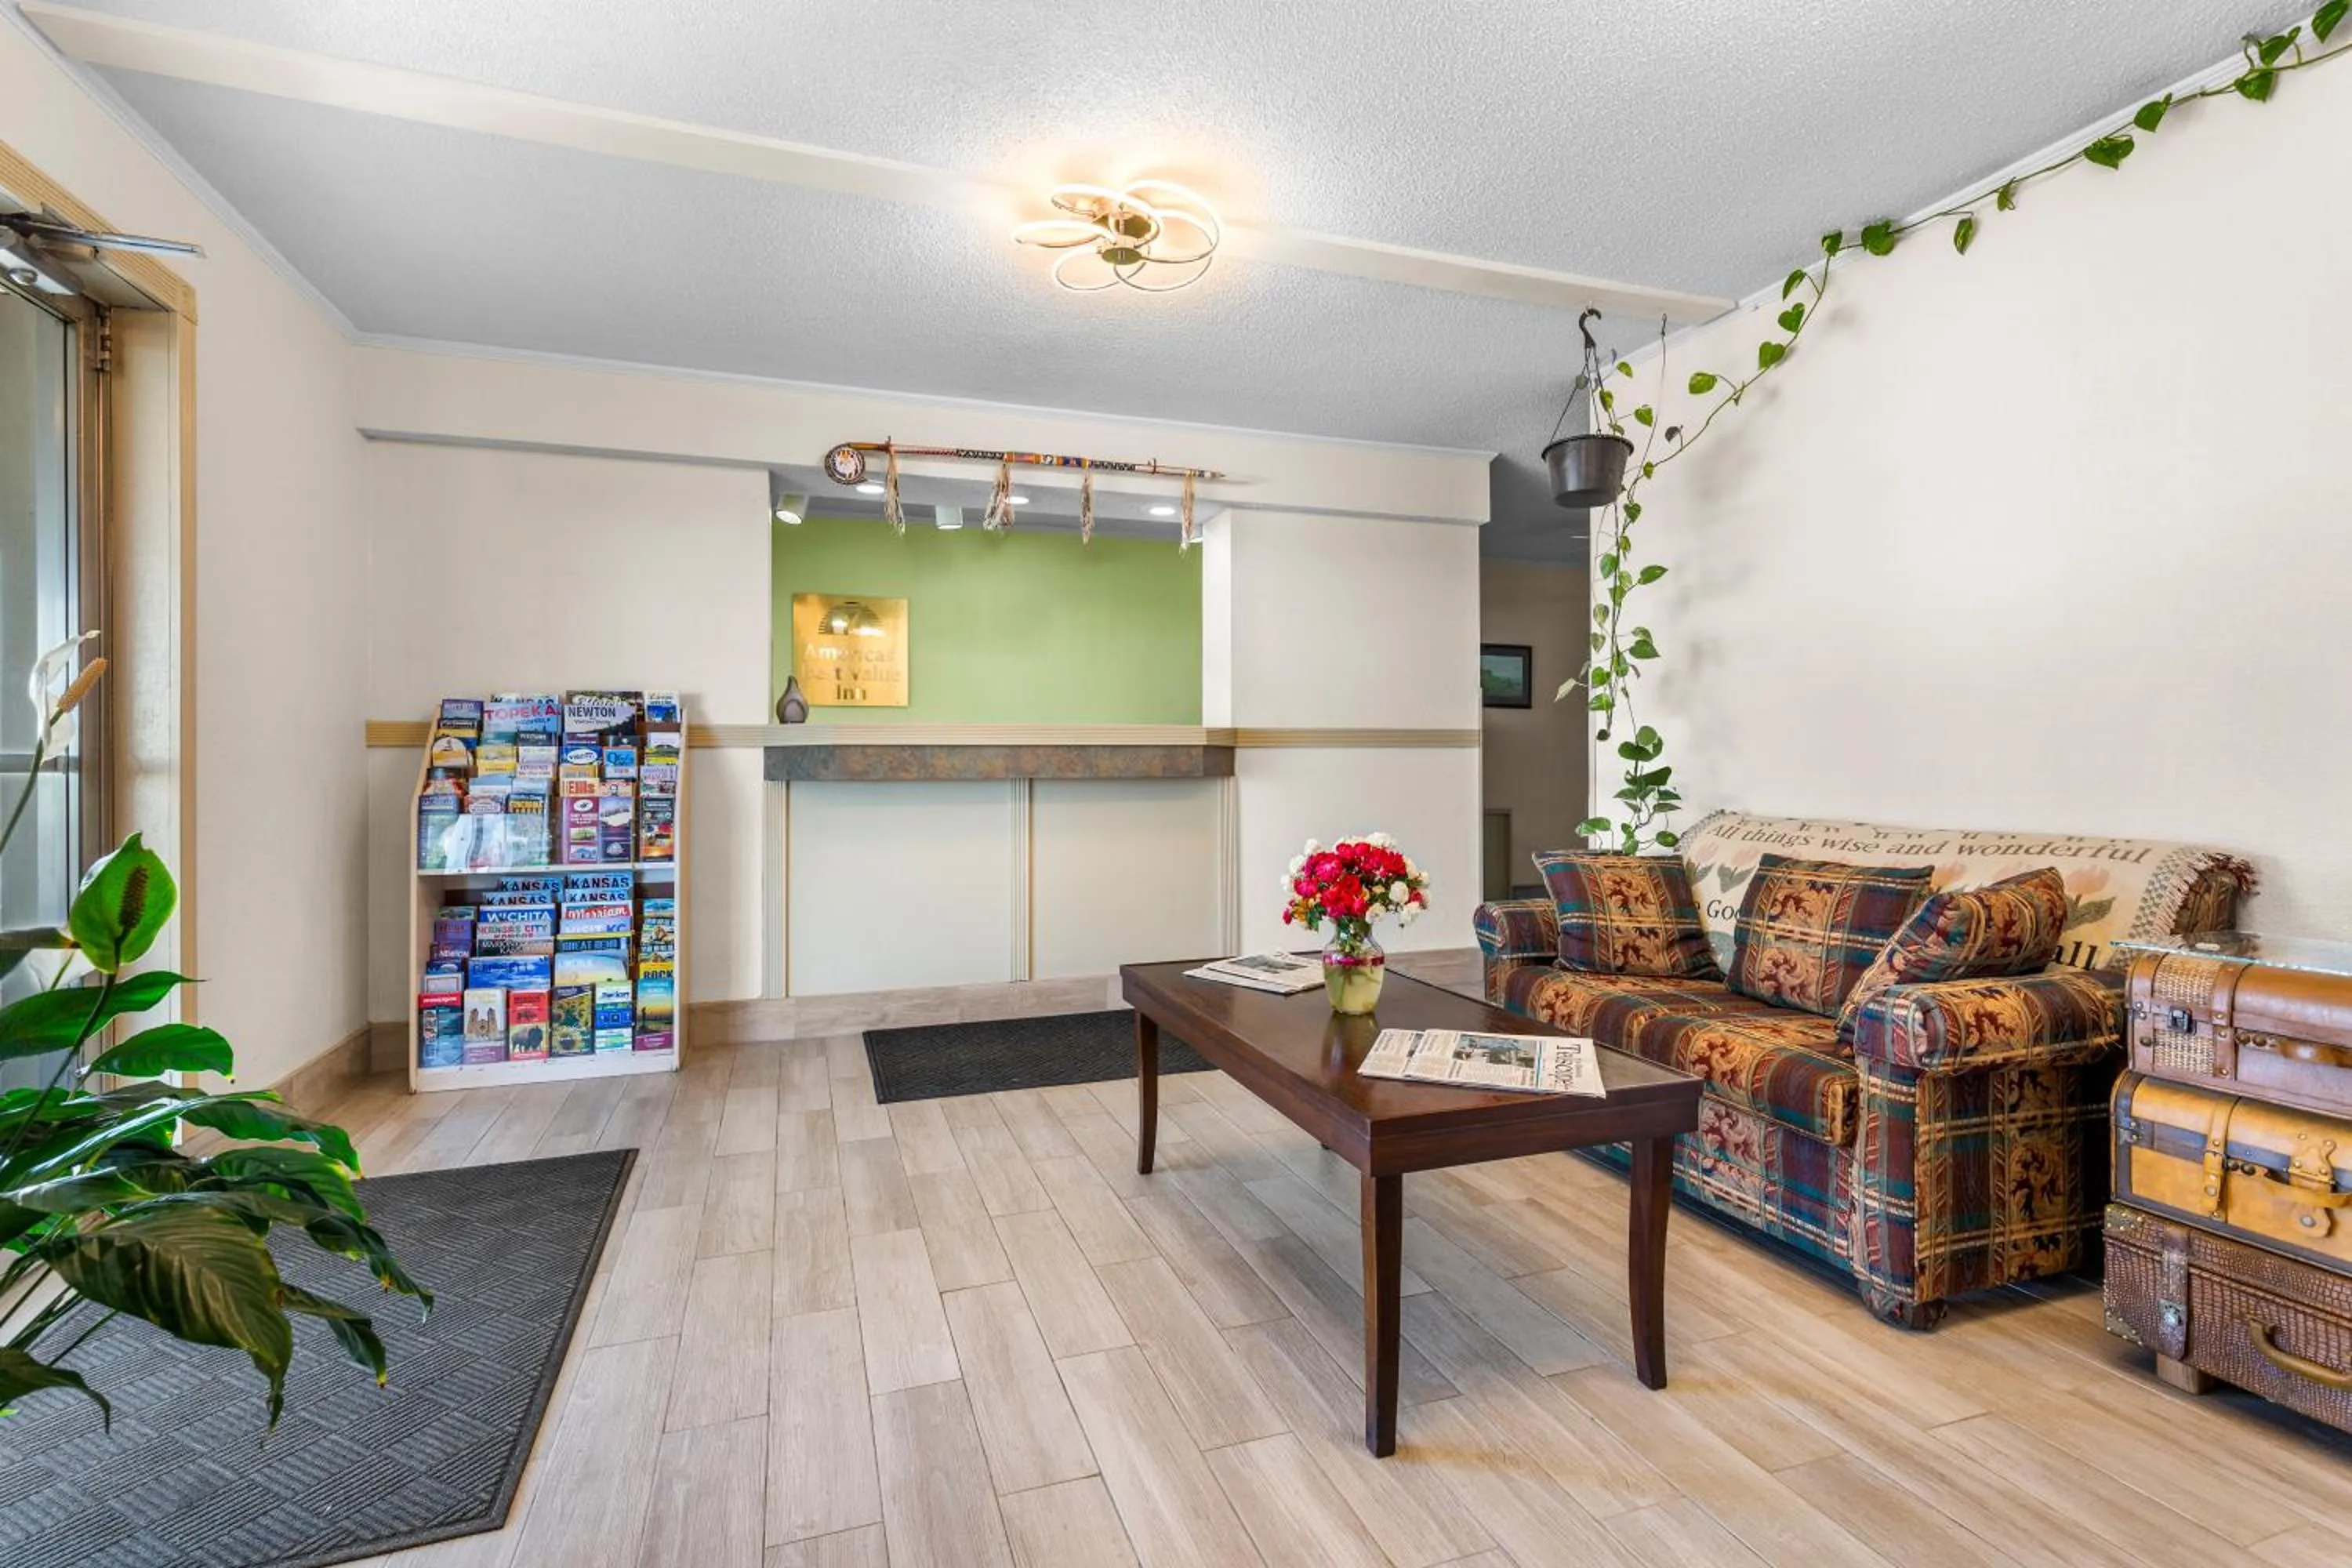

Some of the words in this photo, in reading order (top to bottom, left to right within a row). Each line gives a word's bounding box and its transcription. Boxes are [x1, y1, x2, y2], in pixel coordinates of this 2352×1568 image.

[836, 684, 867, 701] Inn
[568, 706, 616, 717] NEWTON
[1706, 824, 1739, 839] All
[1741, 827, 1815, 848] things
[1821, 837, 1880, 854] wise
[1886, 840, 1950, 855] and
[1958, 840, 2153, 863] wonderful
[501, 881, 560, 893] KANSAS
[571, 877, 630, 888] KANSAS
[487, 896, 546, 905] KANSAS
[569, 893, 625, 902] KANSAS
[1707, 899, 1740, 922] Go
